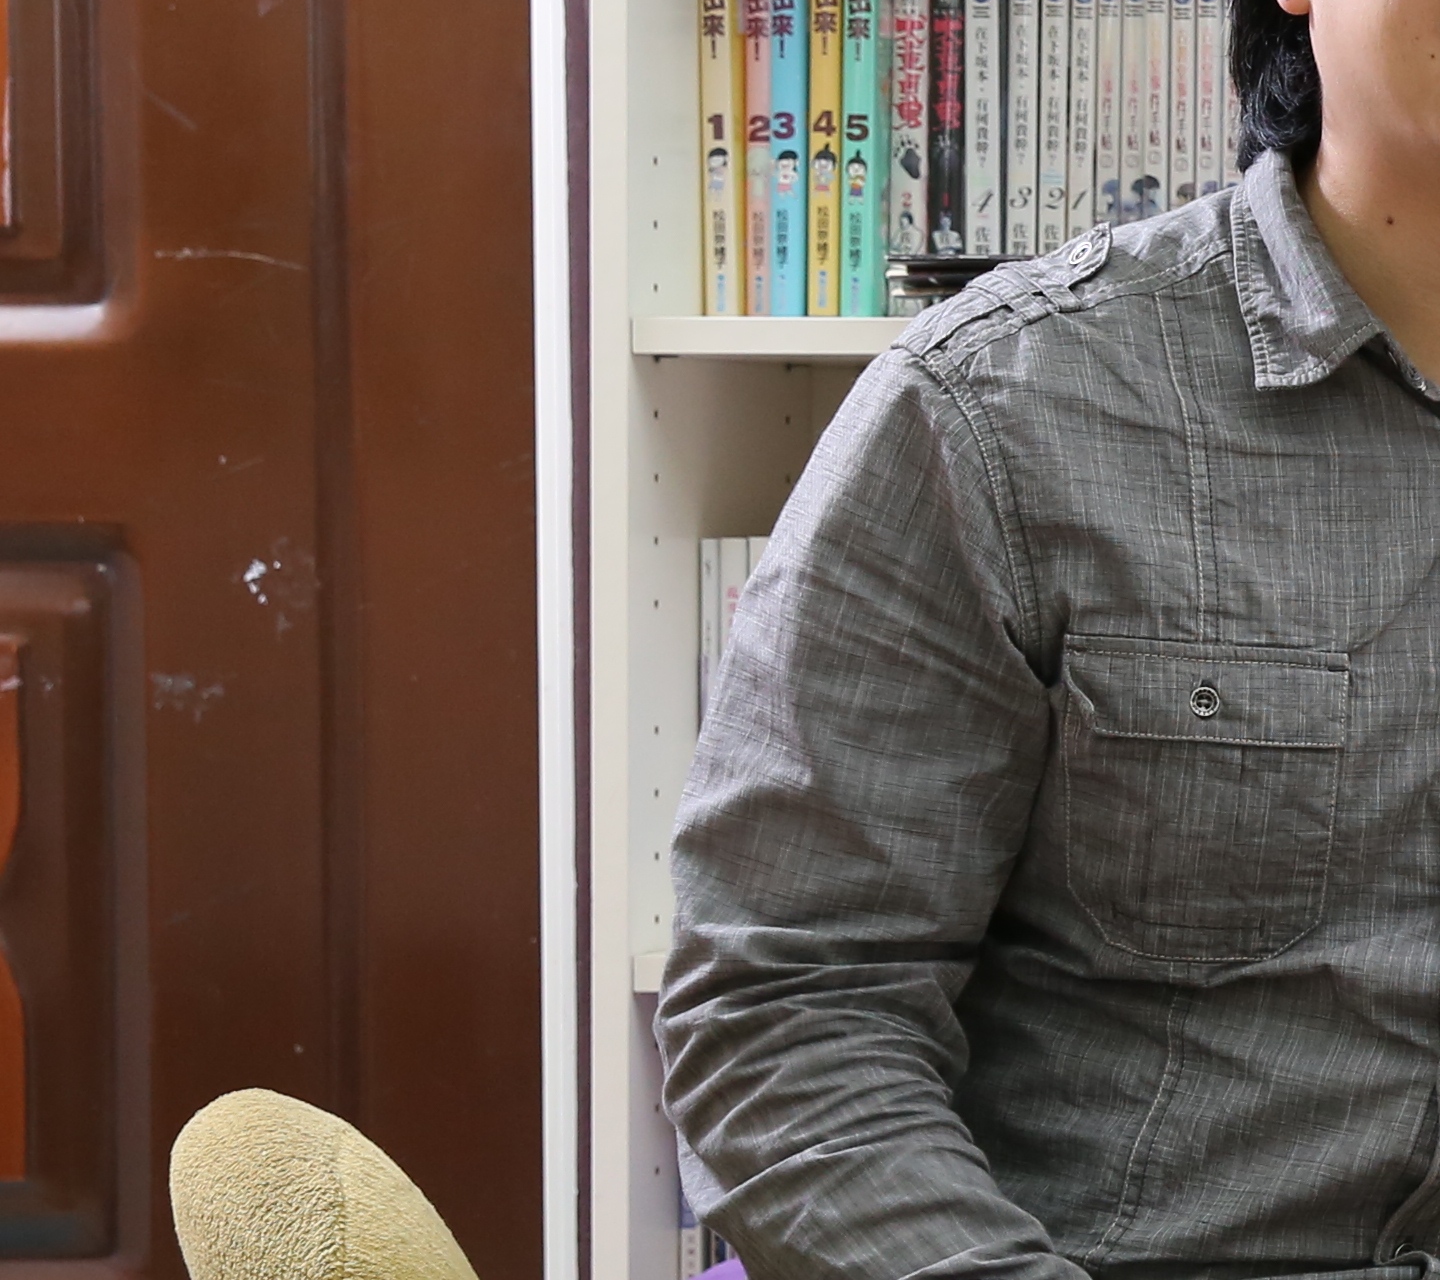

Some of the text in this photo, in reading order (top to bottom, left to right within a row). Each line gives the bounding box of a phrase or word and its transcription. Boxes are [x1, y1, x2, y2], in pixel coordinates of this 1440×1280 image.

[707, 114, 724, 141] 1
[749, 115, 770, 143] 2
[773, 111, 795, 139] 3
[812, 109, 837, 137] 4
[845, 114, 869, 141] 5
[971, 188, 994, 214] 4
[1009, 186, 1032, 210] 3
[1044, 186, 1065, 210] 2
